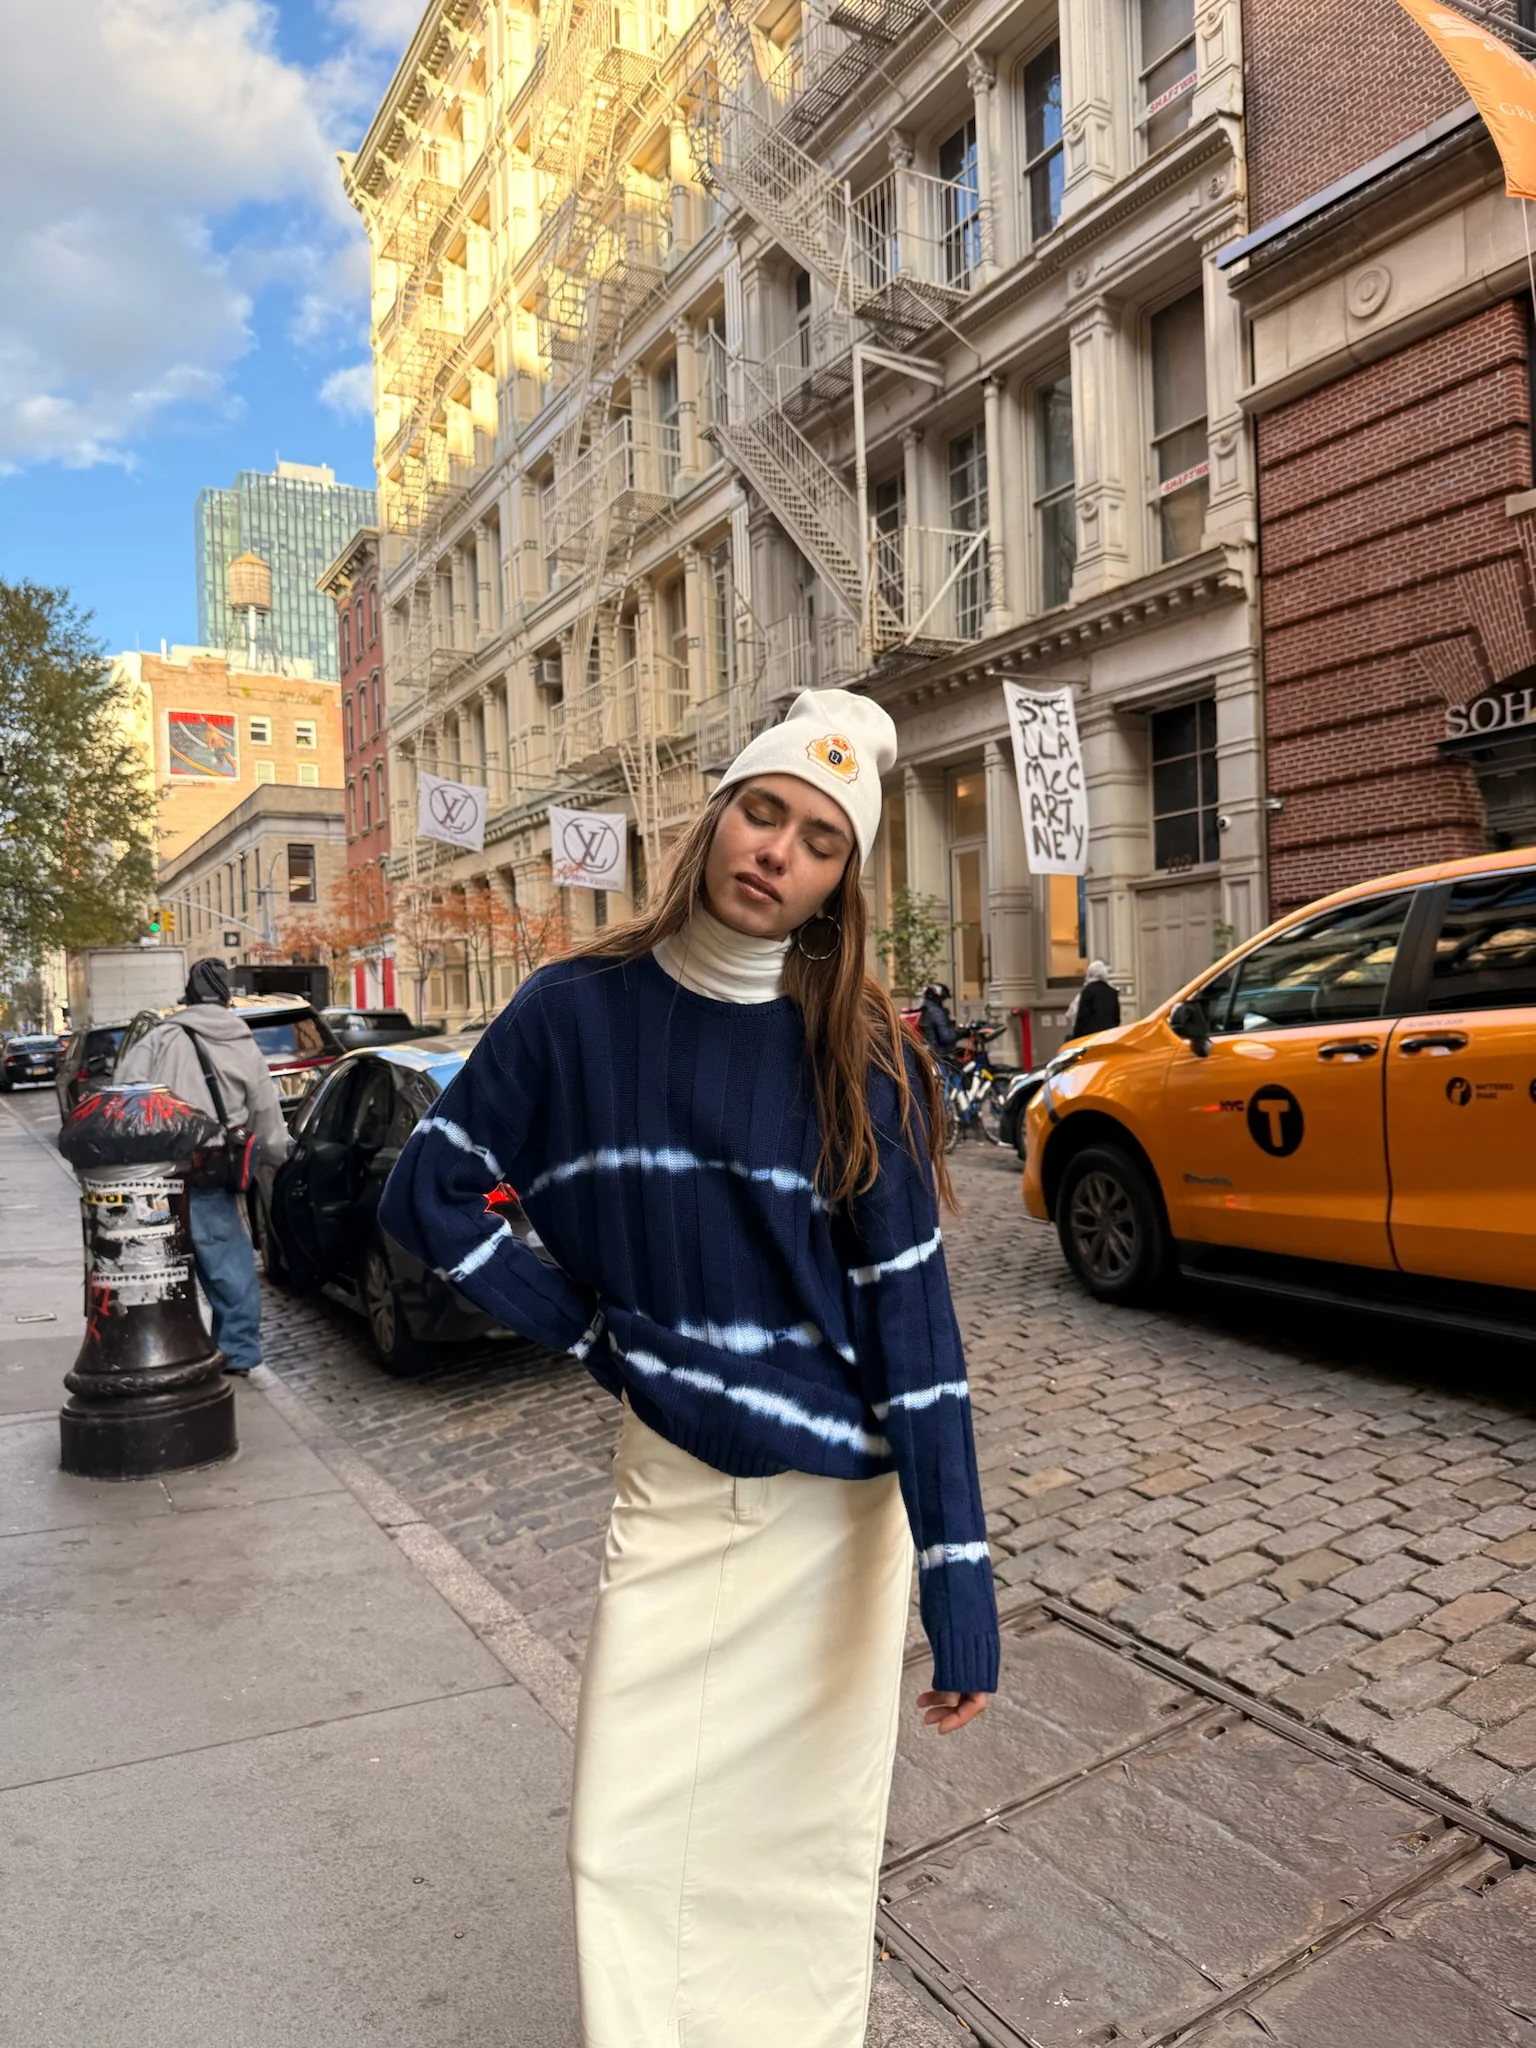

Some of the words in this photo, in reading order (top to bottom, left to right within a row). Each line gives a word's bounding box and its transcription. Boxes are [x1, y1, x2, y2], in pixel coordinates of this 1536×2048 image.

[1016, 698, 1070, 727] STE
[1022, 727, 1073, 761] LLA
[1031, 793, 1073, 835] ART
[1032, 825, 1084, 861] NEY
[1258, 1099, 1290, 1148] T
